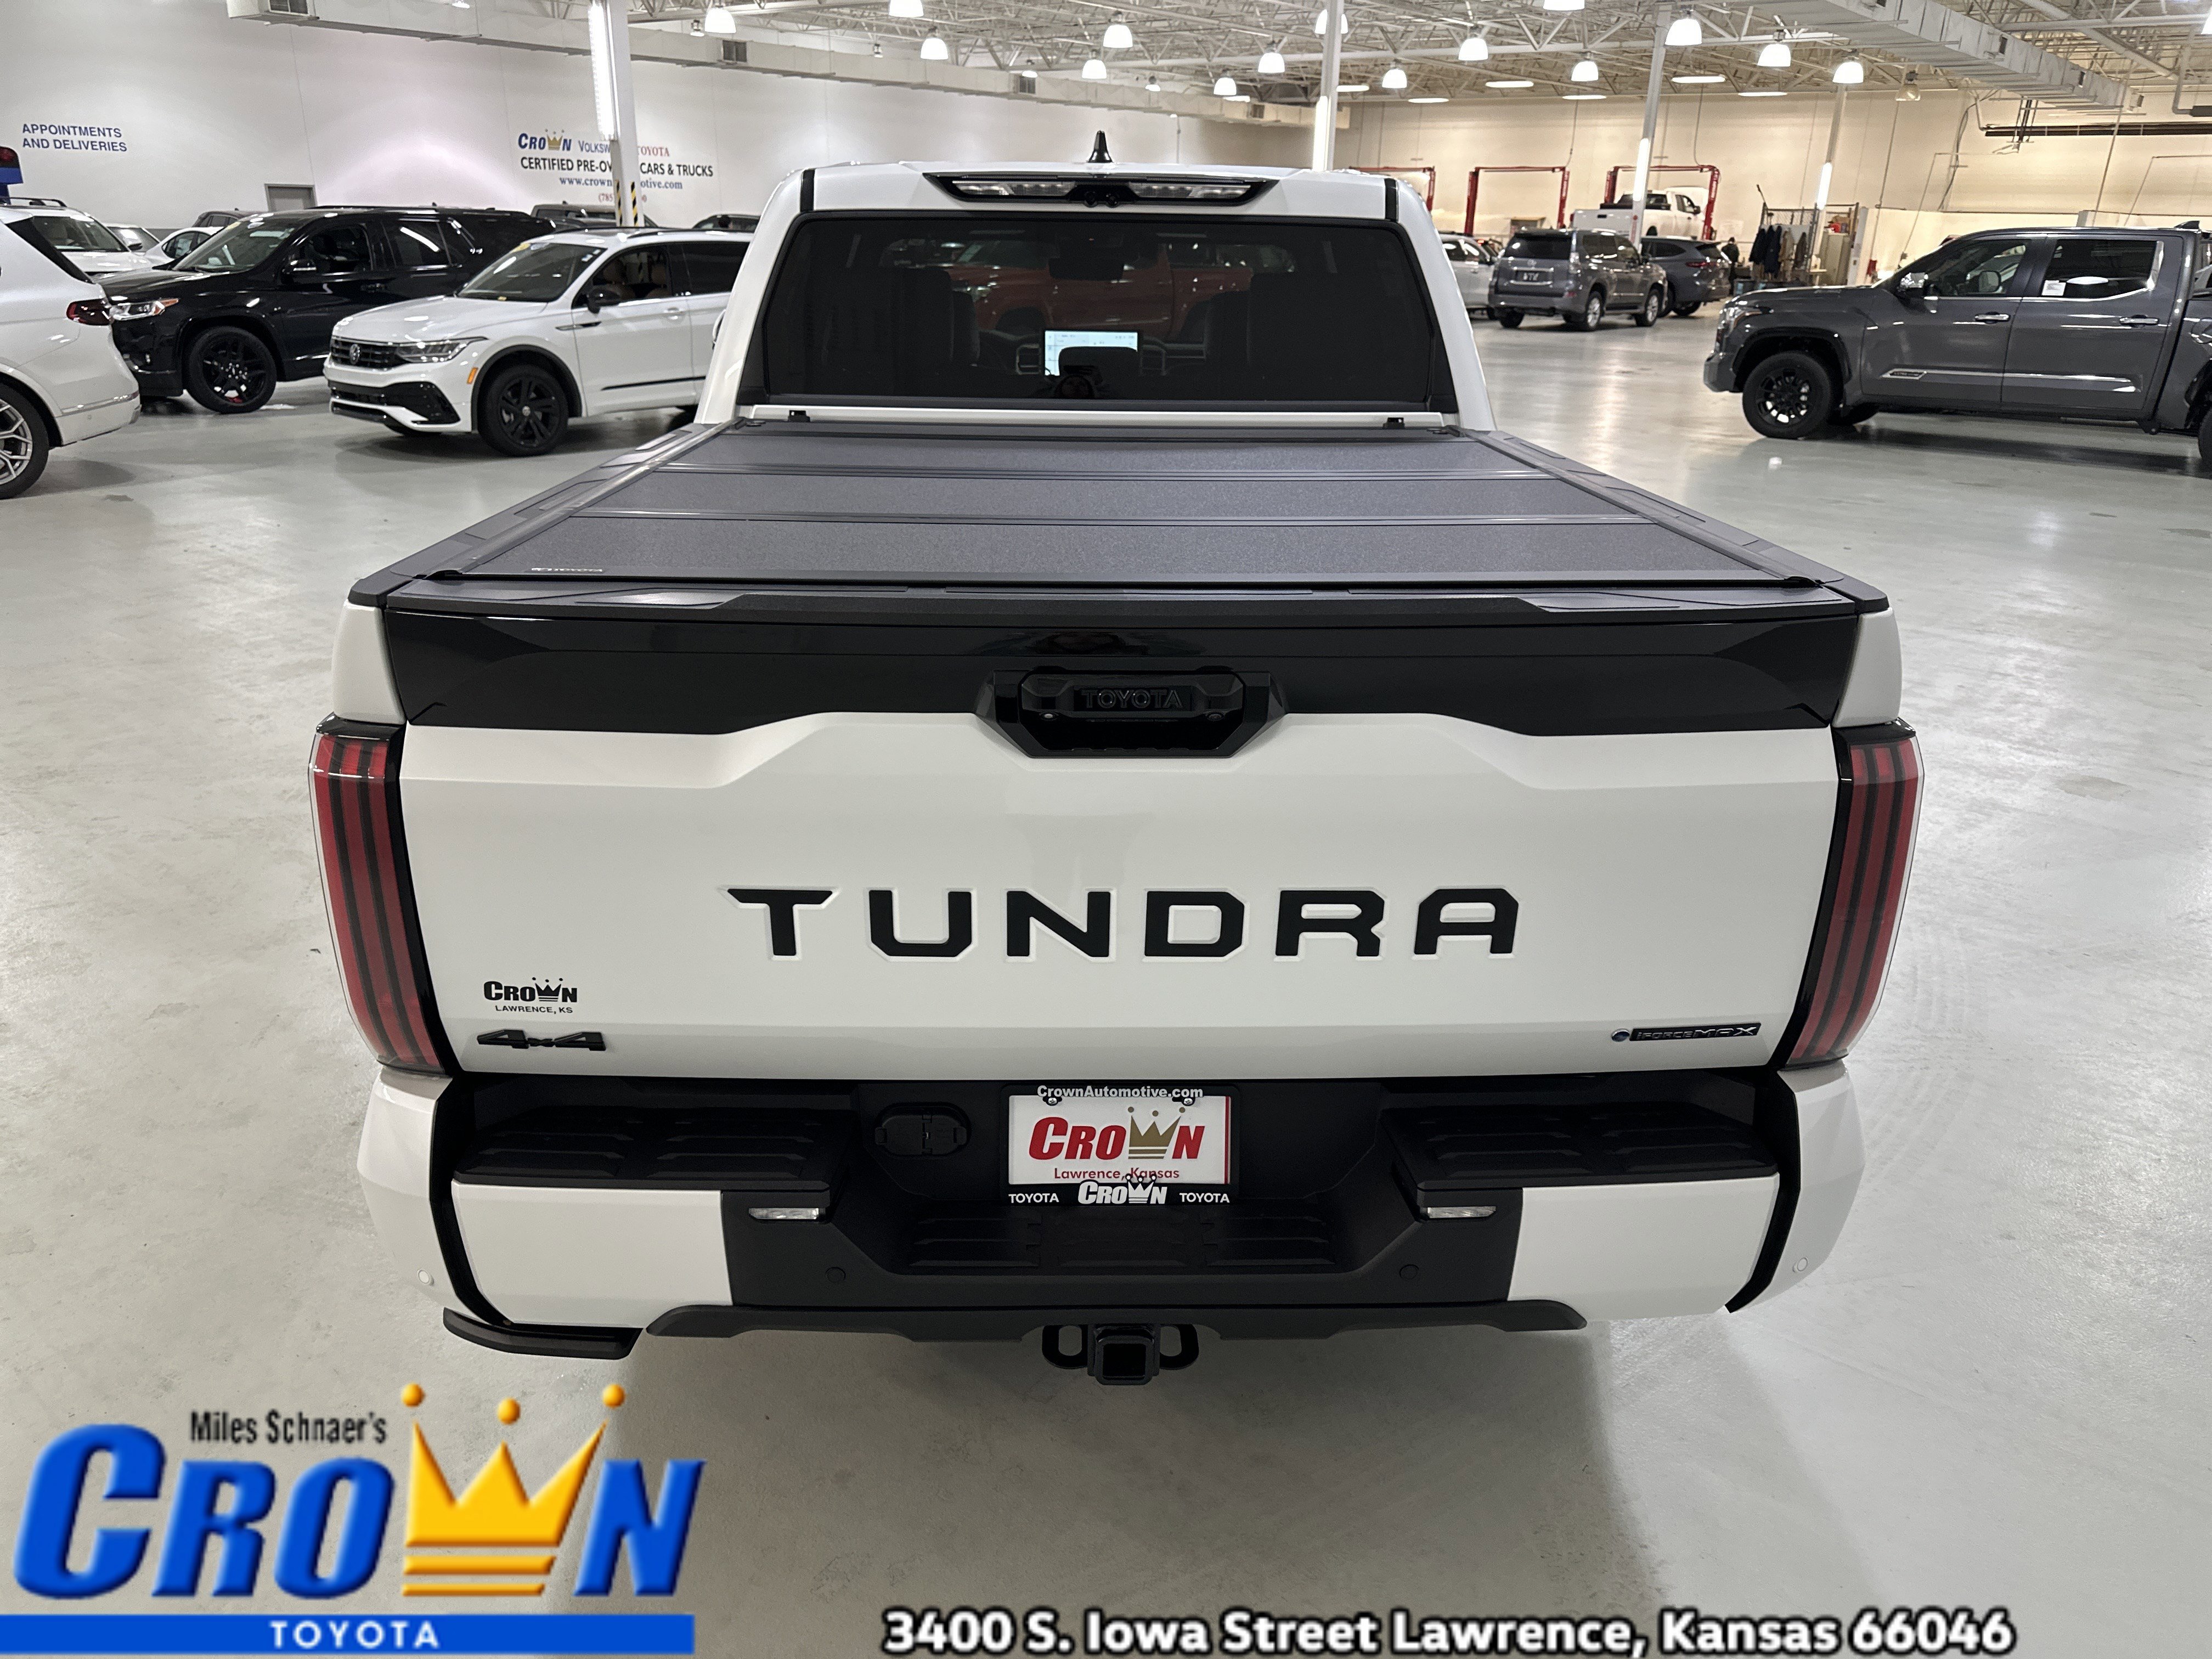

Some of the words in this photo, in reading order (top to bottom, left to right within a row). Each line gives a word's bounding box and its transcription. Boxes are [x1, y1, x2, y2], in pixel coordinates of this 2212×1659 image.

[22, 123, 122, 138] APPOINTMENTS
[22, 138, 50, 149] AND
[53, 139, 127, 152] DELIVERIES
[518, 129, 572, 151] CROWN
[578, 140, 610, 153] VOLKSW
[521, 157, 574, 171] CERTIFIED
[577, 160, 612, 173] PRE-O
[640, 162, 664, 175] CARS
[668, 163, 674, 175] &
[675, 164, 713, 177] TRUCKS
[1081, 689, 1183, 709] TOYOTA
[726, 888, 1521, 959] TUNDRA
[483, 977, 578, 1003] CROWN
[495, 1005, 556, 1014] LAWRENCE,
[1037, 1086, 1204, 1098] CrownAutomotive.com
[1029, 1106, 1205, 1160] CROWN
[1054, 1167, 1125, 1181] Lawrence,
[1130, 1167, 1180, 1179] Kansas
[1008, 1193, 1059, 1204] TOYOTA
[1077, 1175, 1167, 1205] CROWN
[1179, 1192, 1230, 1204] TOYOTA
